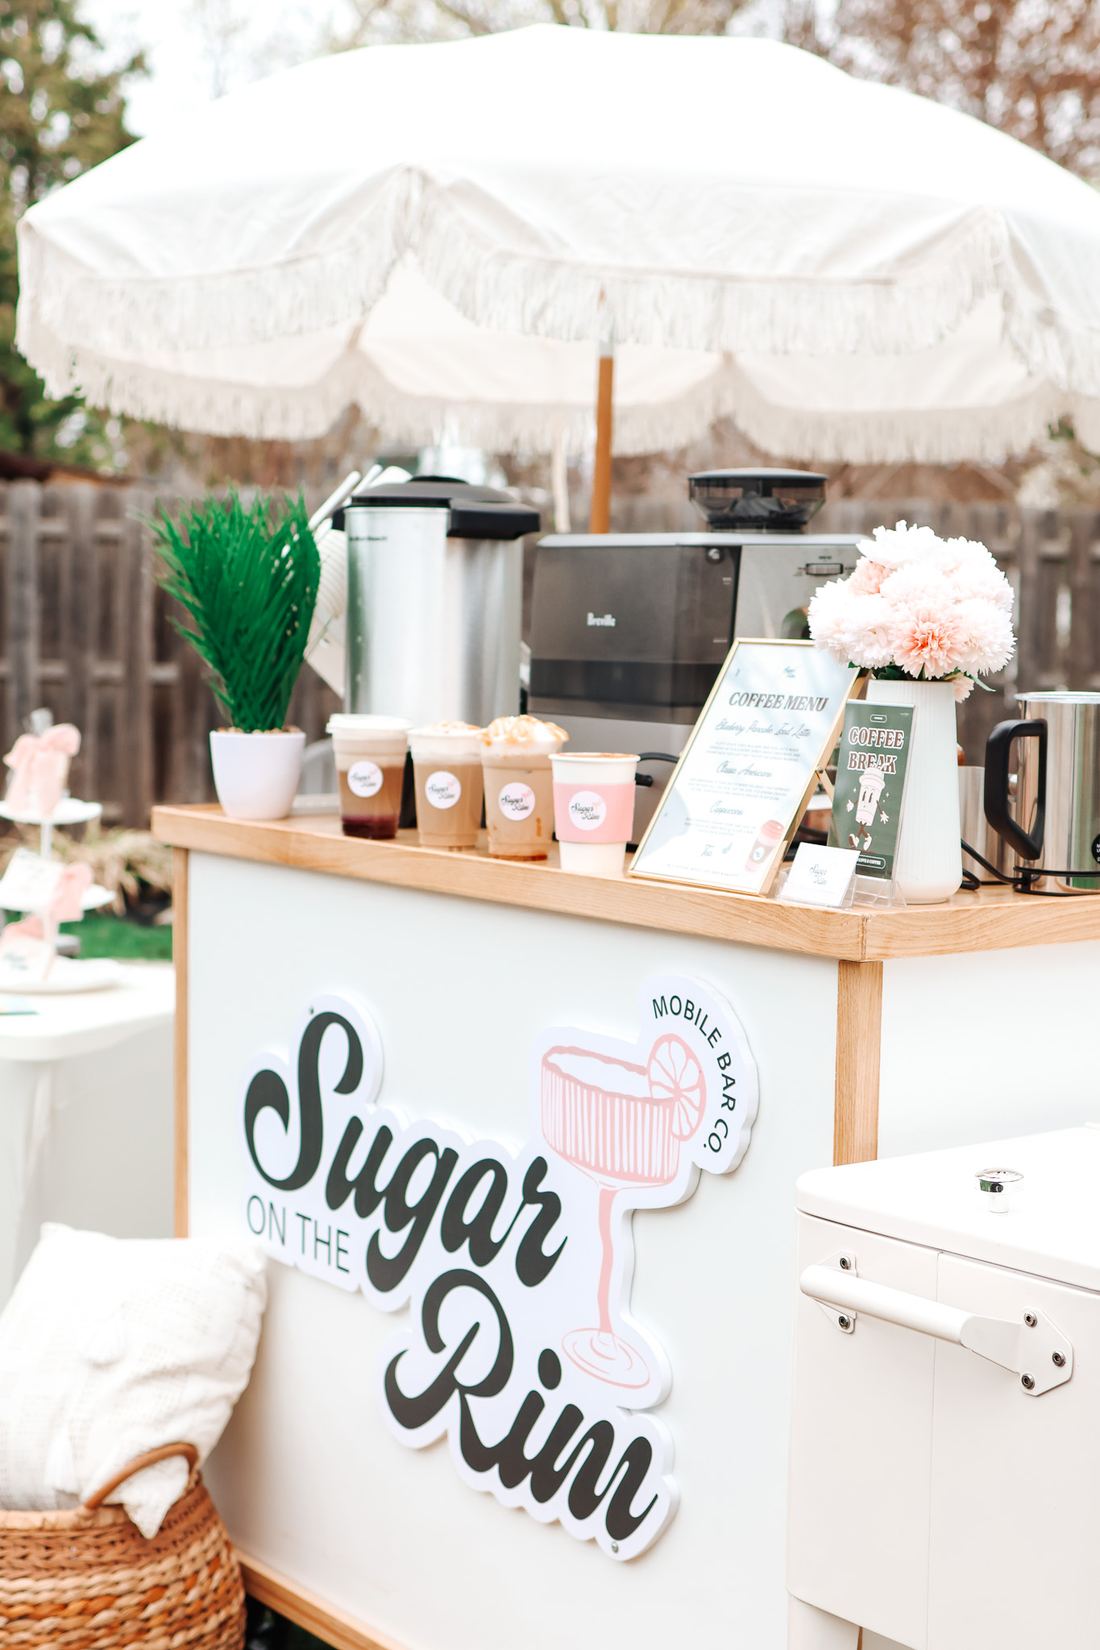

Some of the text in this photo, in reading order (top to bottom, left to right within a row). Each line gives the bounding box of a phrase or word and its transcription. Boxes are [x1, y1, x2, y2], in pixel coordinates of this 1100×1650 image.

[729, 691, 829, 712] COFFEE MENU
[849, 727, 904, 749] COFFEE
[848, 752, 897, 774] BREAK
[653, 995, 736, 1153] MOBILE BAR CO.
[244, 1011, 568, 1293] Sugar
[246, 1194, 352, 1274] ON THE
[385, 1269, 659, 1541] Rim
